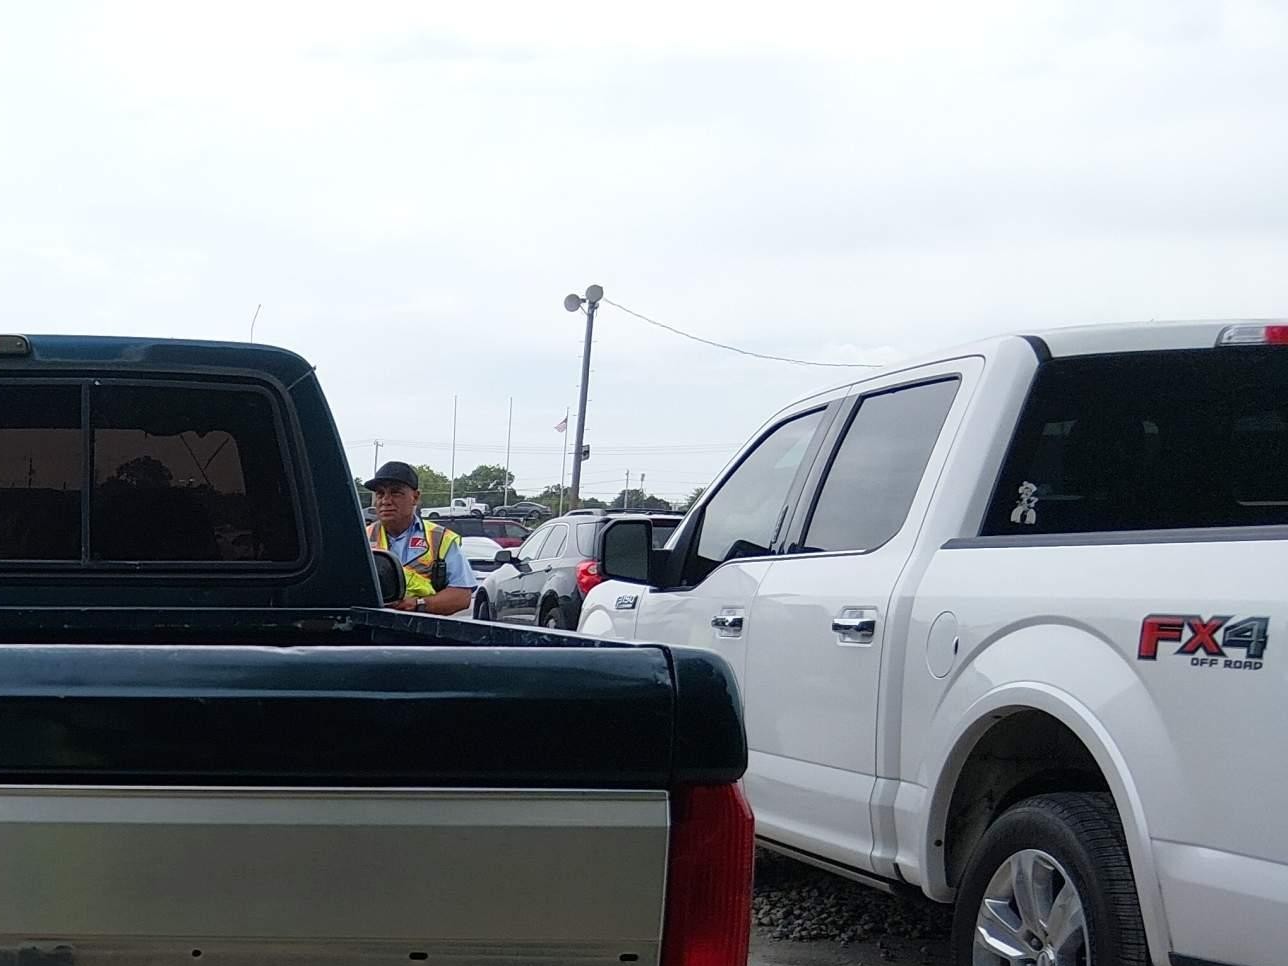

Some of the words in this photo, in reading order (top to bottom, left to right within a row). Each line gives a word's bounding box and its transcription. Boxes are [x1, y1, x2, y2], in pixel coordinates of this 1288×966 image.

[1137, 613, 1270, 661] FX4
[1190, 657, 1219, 668] OFF
[1223, 659, 1263, 671] ROAD
